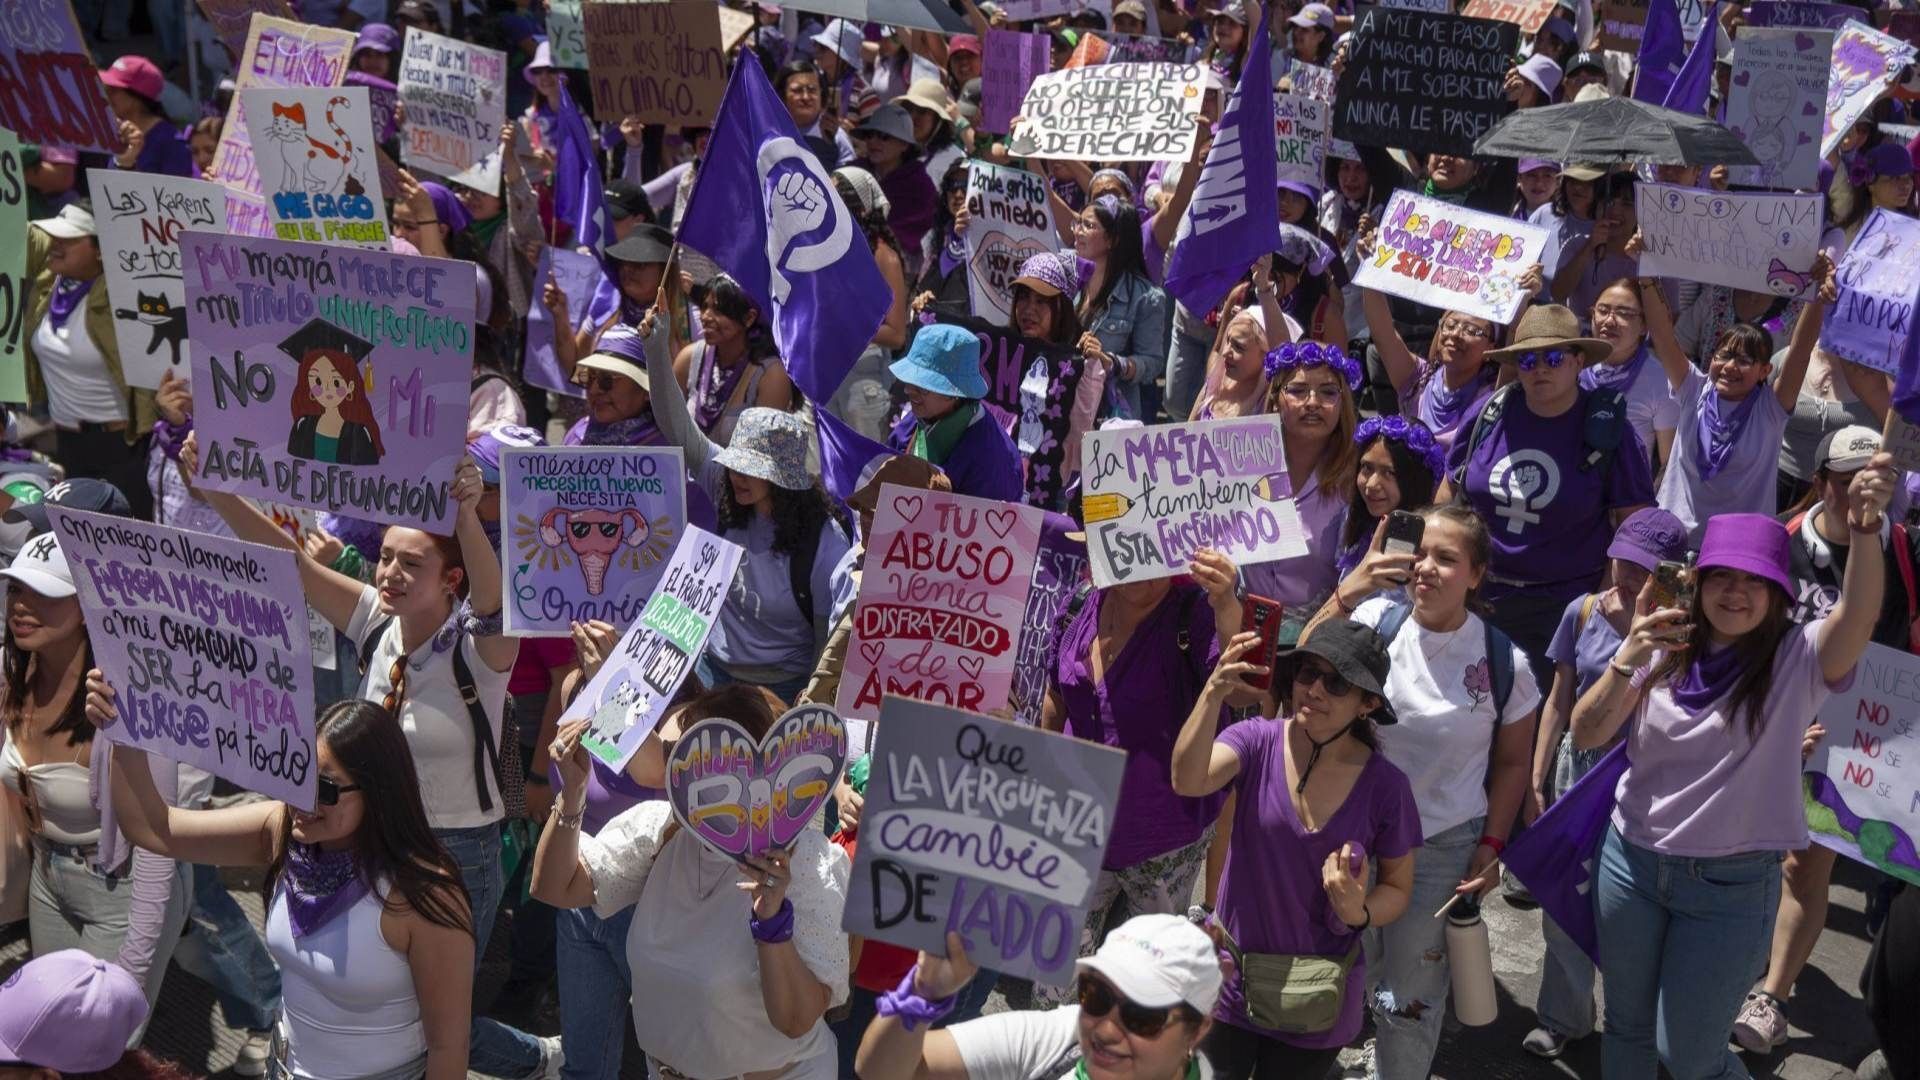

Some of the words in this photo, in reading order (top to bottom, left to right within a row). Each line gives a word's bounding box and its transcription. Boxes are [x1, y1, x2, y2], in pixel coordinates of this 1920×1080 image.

[1360, 10, 1375, 35] A
[1419, 18, 1447, 44] ME
[1369, 38, 1433, 68] MARCHO
[1026, 82, 1062, 100] NO
[1066, 79, 1174, 101] QUIERE
[1357, 65, 1373, 91] A
[1024, 99, 1055, 118] TU
[1041, 114, 1143, 132] QUIERE
[1151, 112, 1198, 131] SUS
[1276, 119, 1293, 137] NO
[1346, 101, 1400, 129] NUNCA
[1410, 105, 1433, 131] LE
[1042, 131, 1190, 156] DERECHOS
[968, 193, 986, 220] el
[990, 196, 1048, 232] miedo
[1641, 186, 1686, 215] NO
[1694, 194, 1748, 221] SOY
[1755, 199, 1818, 227] UNA
[1373, 245, 1396, 269] Y
[1430, 219, 1526, 263] QUEREMOS
[338, 255, 448, 309] MERECE
[318, 295, 468, 354] UNIVERSITARIO
[209, 350, 277, 412] NO
[202, 436, 270, 489] ACTA
[274, 459, 308, 504] DE
[310, 465, 450, 524] DEFUNCIÓN
[522, 475, 600, 492] necesita
[622, 455, 657, 477] NO
[557, 491, 637, 507] NECESITA
[933, 502, 978, 539] TU
[27, 536, 57, 562] NY
[881, 529, 1014, 586] ABUSO
[625, 628, 652, 659] DE
[862, 606, 1000, 650] DISFRAZADO
[159, 615, 258, 679] CAPACIDAD
[265, 648, 298, 692] de
[888, 641, 949, 681] de
[126, 641, 183, 697] SER
[229, 678, 301, 737] MERA
[1856, 697, 1890, 727] NO
[1893, 718, 1914, 739] SE
[244, 722, 312, 787] todo
[671, 728, 755, 788] MIJA
[763, 710, 847, 779] DREAM
[1852, 727, 1882, 760] NO
[1883, 750, 1902, 769] SE
[887, 751, 934, 803] LA
[936, 756, 1106, 848] VERGÜENZA
[1842, 759, 1875, 789] NO
[1875, 781, 1893, 800] SE
[687, 753, 835, 858] BIG
[870, 857, 940, 931] DE
